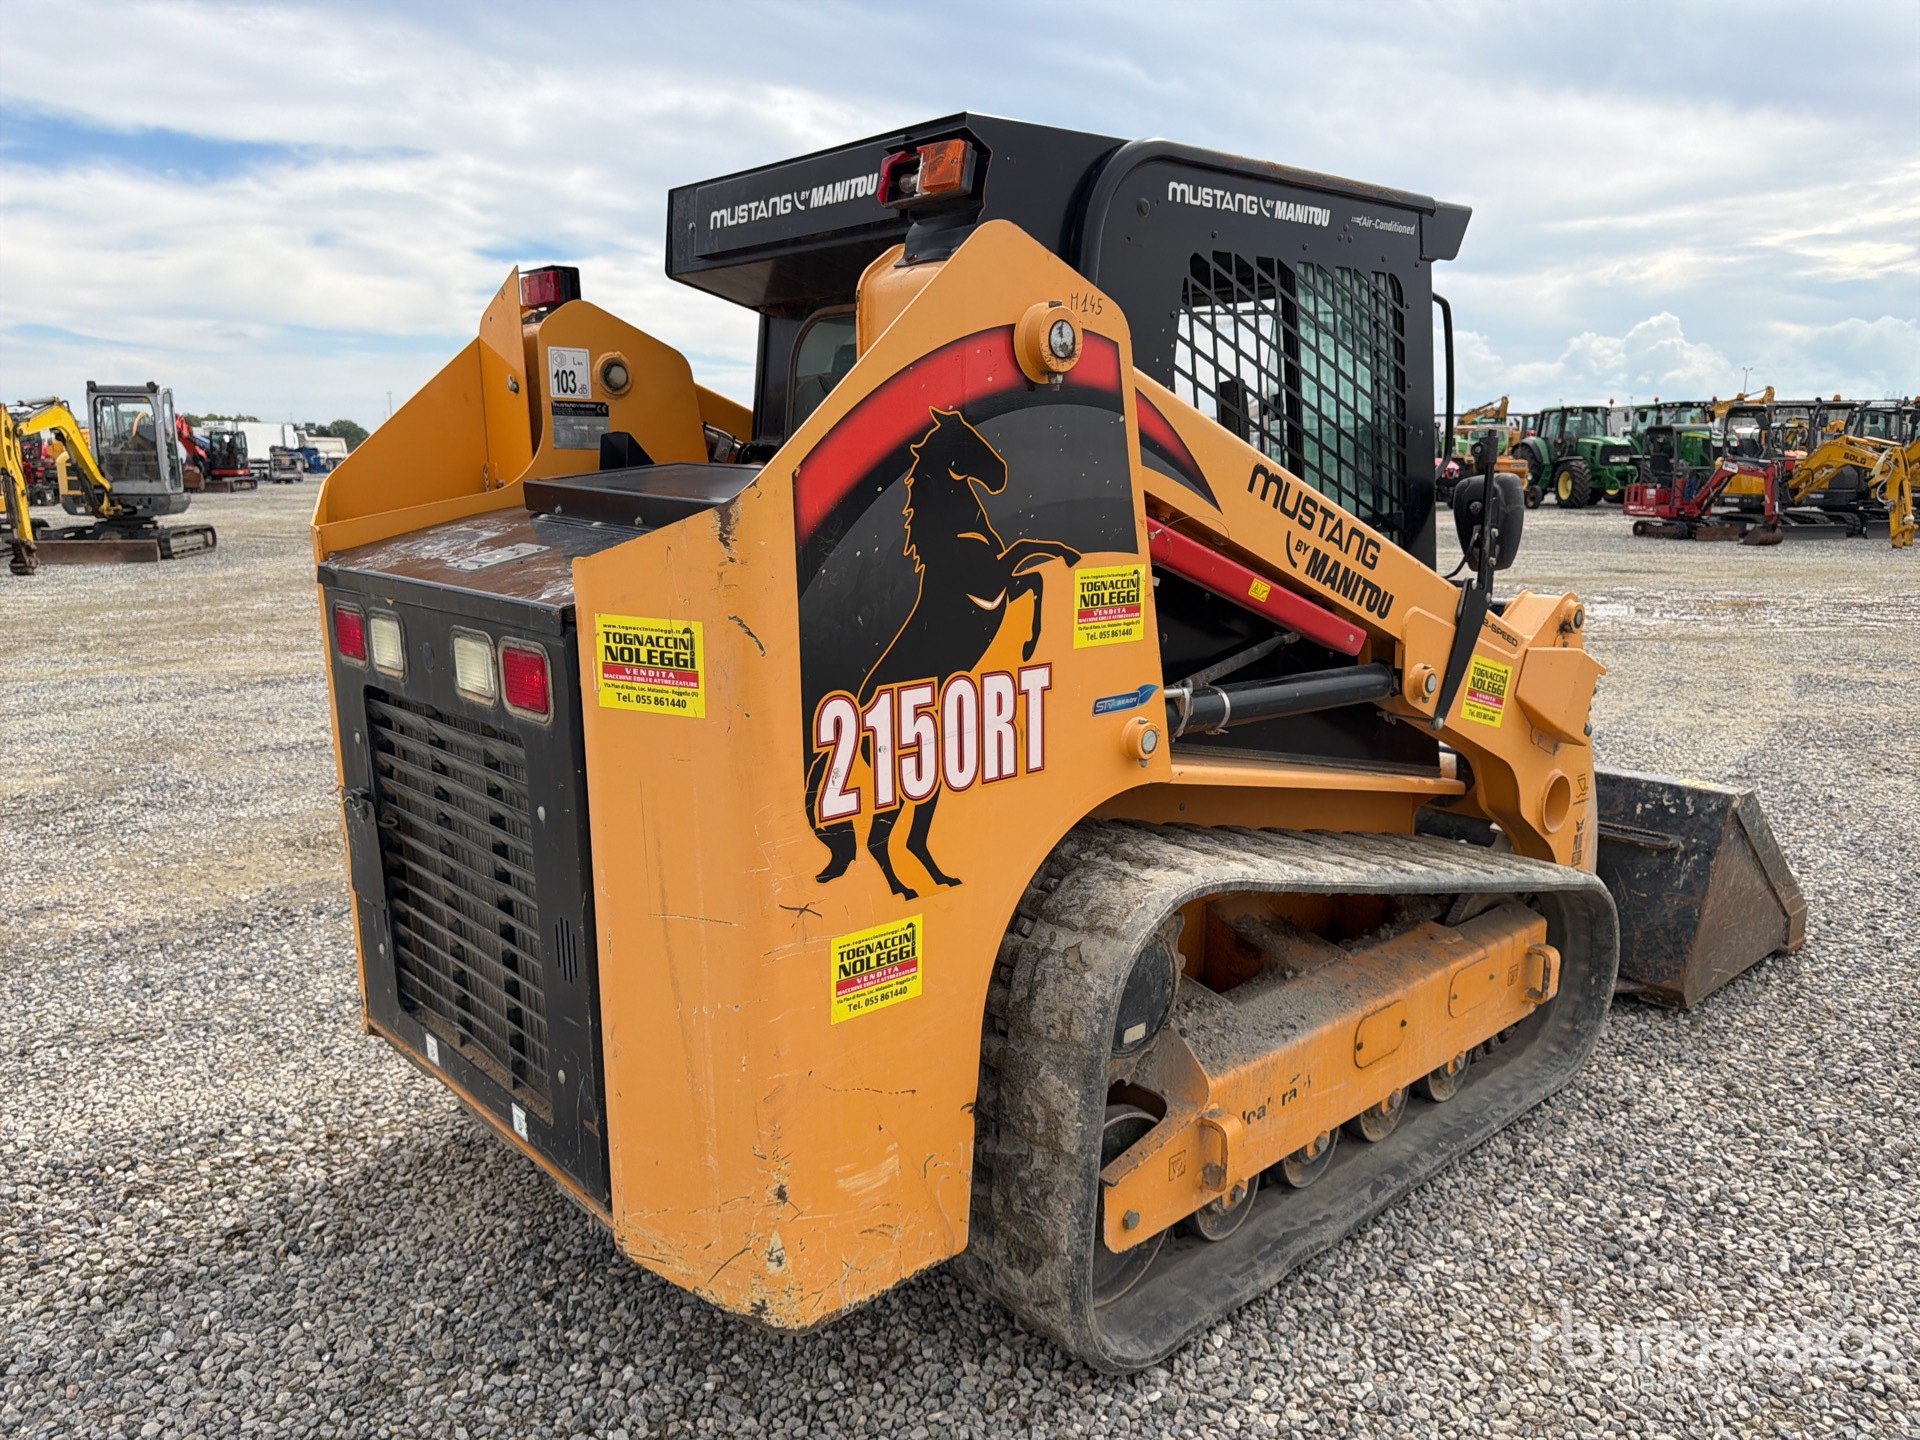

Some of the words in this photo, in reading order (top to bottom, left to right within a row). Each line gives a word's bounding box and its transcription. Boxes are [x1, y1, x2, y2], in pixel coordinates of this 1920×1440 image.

[710, 194, 791, 230] MUSTANG
[801, 190, 810, 200] BY
[810, 173, 878, 208] MANITOU
[1168, 181, 1257, 215] MUSTANG
[1266, 200, 1274, 208] BY
[1275, 201, 1330, 227] MANITOU
[1362, 216, 1415, 235] Air-Conditioned
[554, 369, 576, 394] 103
[578, 384, 587, 394] dB
[597, 405, 606, 413] CE
[1844, 453, 1866, 464] SDLG
[1248, 463, 1380, 570] MUSTANG
[1295, 540, 1310, 555] BY
[1304, 547, 1394, 619] MANITOU
[1094, 608, 1126, 616] VENDITA
[1086, 632, 1097, 640] Tel.
[1099, 631, 1110, 639] 055
[1111, 628, 1132, 637] 861440
[625, 668, 675, 679] VENDITA
[616, 692, 633, 702] Tel.
[636, 695, 651, 705] 055
[654, 696, 686, 709] 861440
[1117, 697, 1137, 705] READY
[817, 663, 1052, 822] 2150RT
[857, 966, 898, 983] VENDITA
[848, 1001, 863, 1012] Tel.
[865, 995, 878, 1007] 055
[880, 986, 907, 1002] 861440
